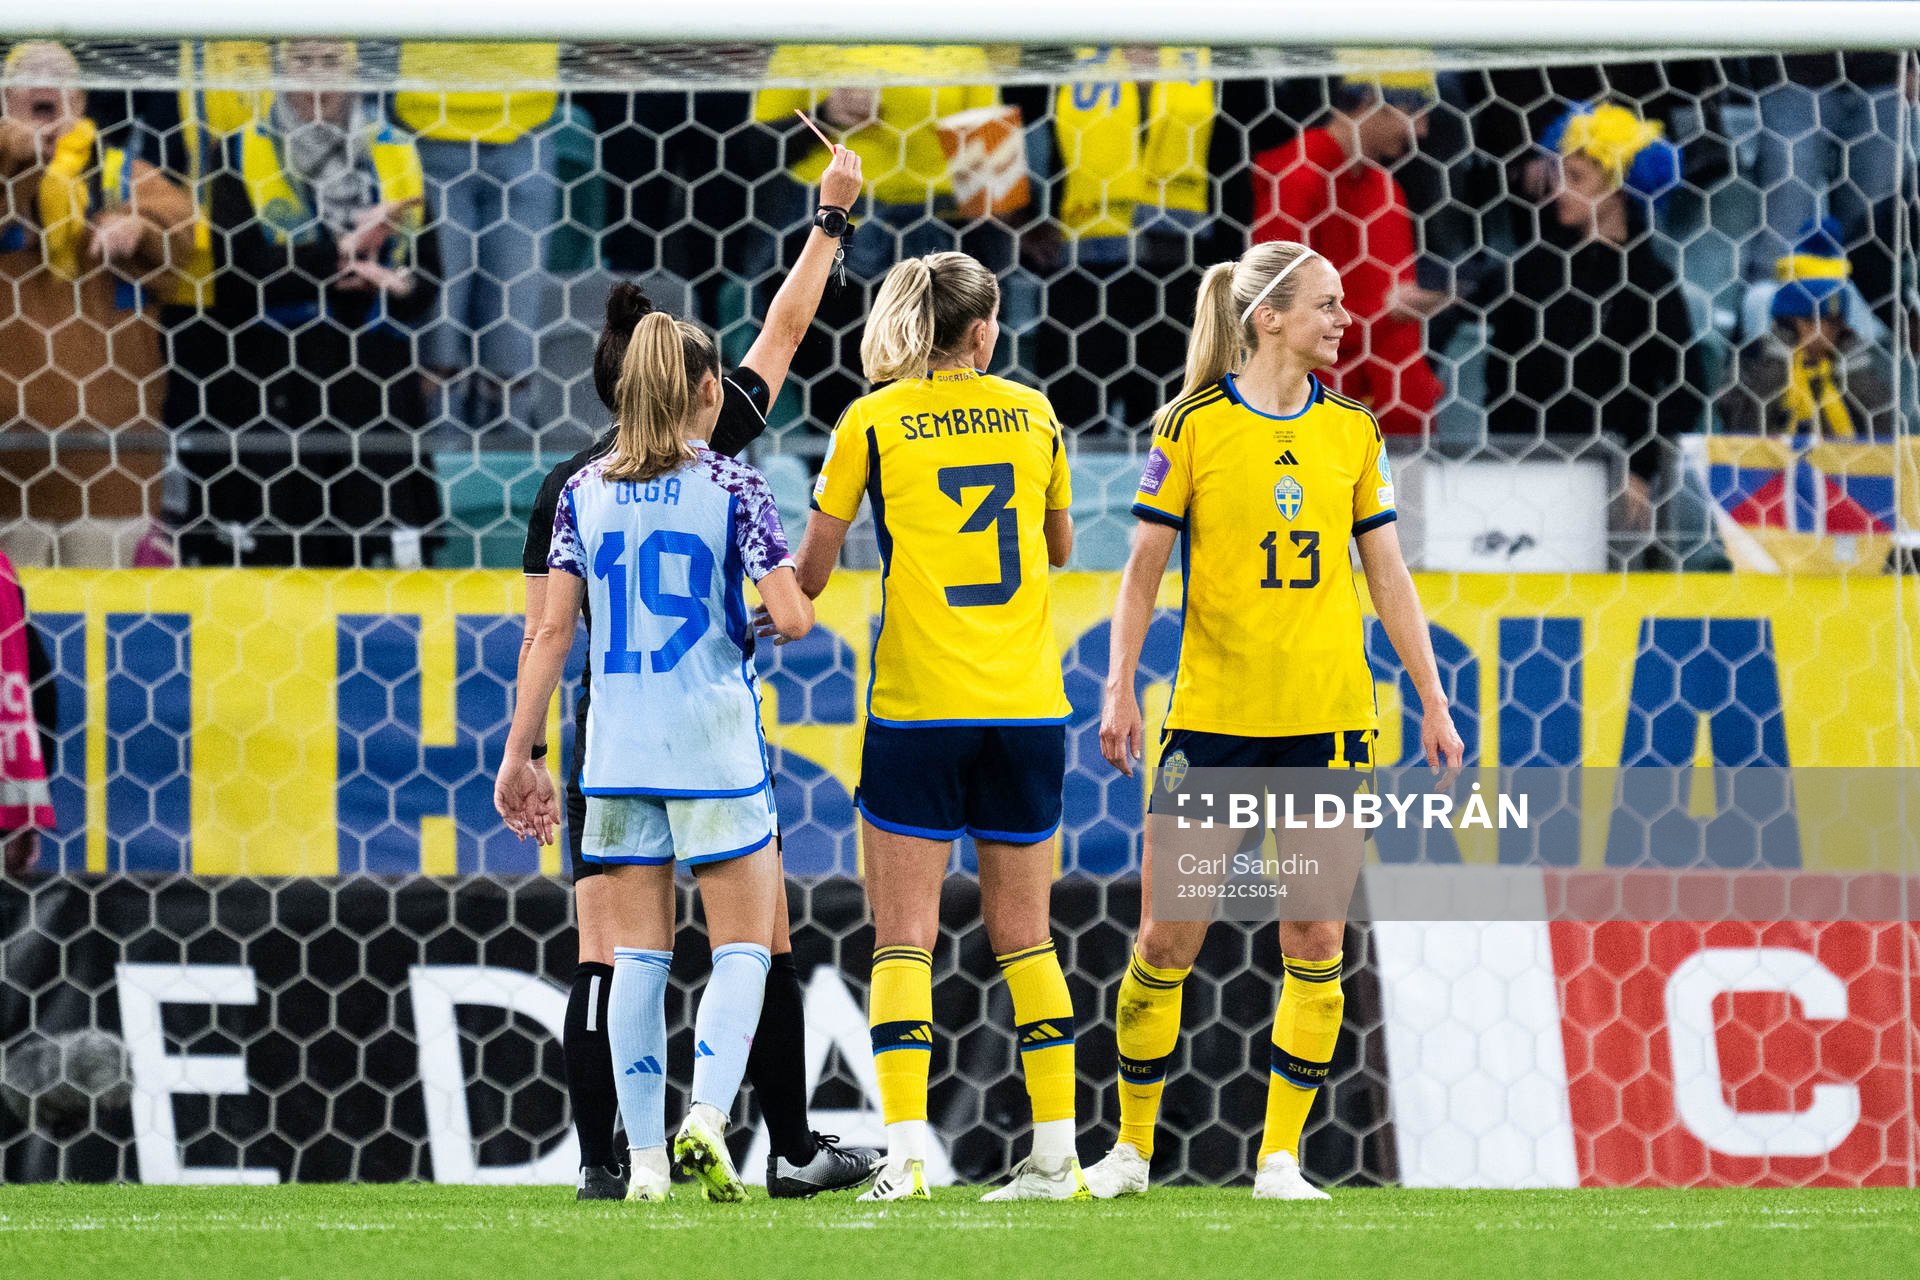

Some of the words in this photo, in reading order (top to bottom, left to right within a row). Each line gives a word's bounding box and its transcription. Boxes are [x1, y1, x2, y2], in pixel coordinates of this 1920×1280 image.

[900, 407, 1030, 440] SEMBRANT
[615, 477, 682, 506] OLGA
[937, 462, 1022, 607] 3
[1259, 530, 1321, 588] 13
[593, 529, 715, 675] 19
